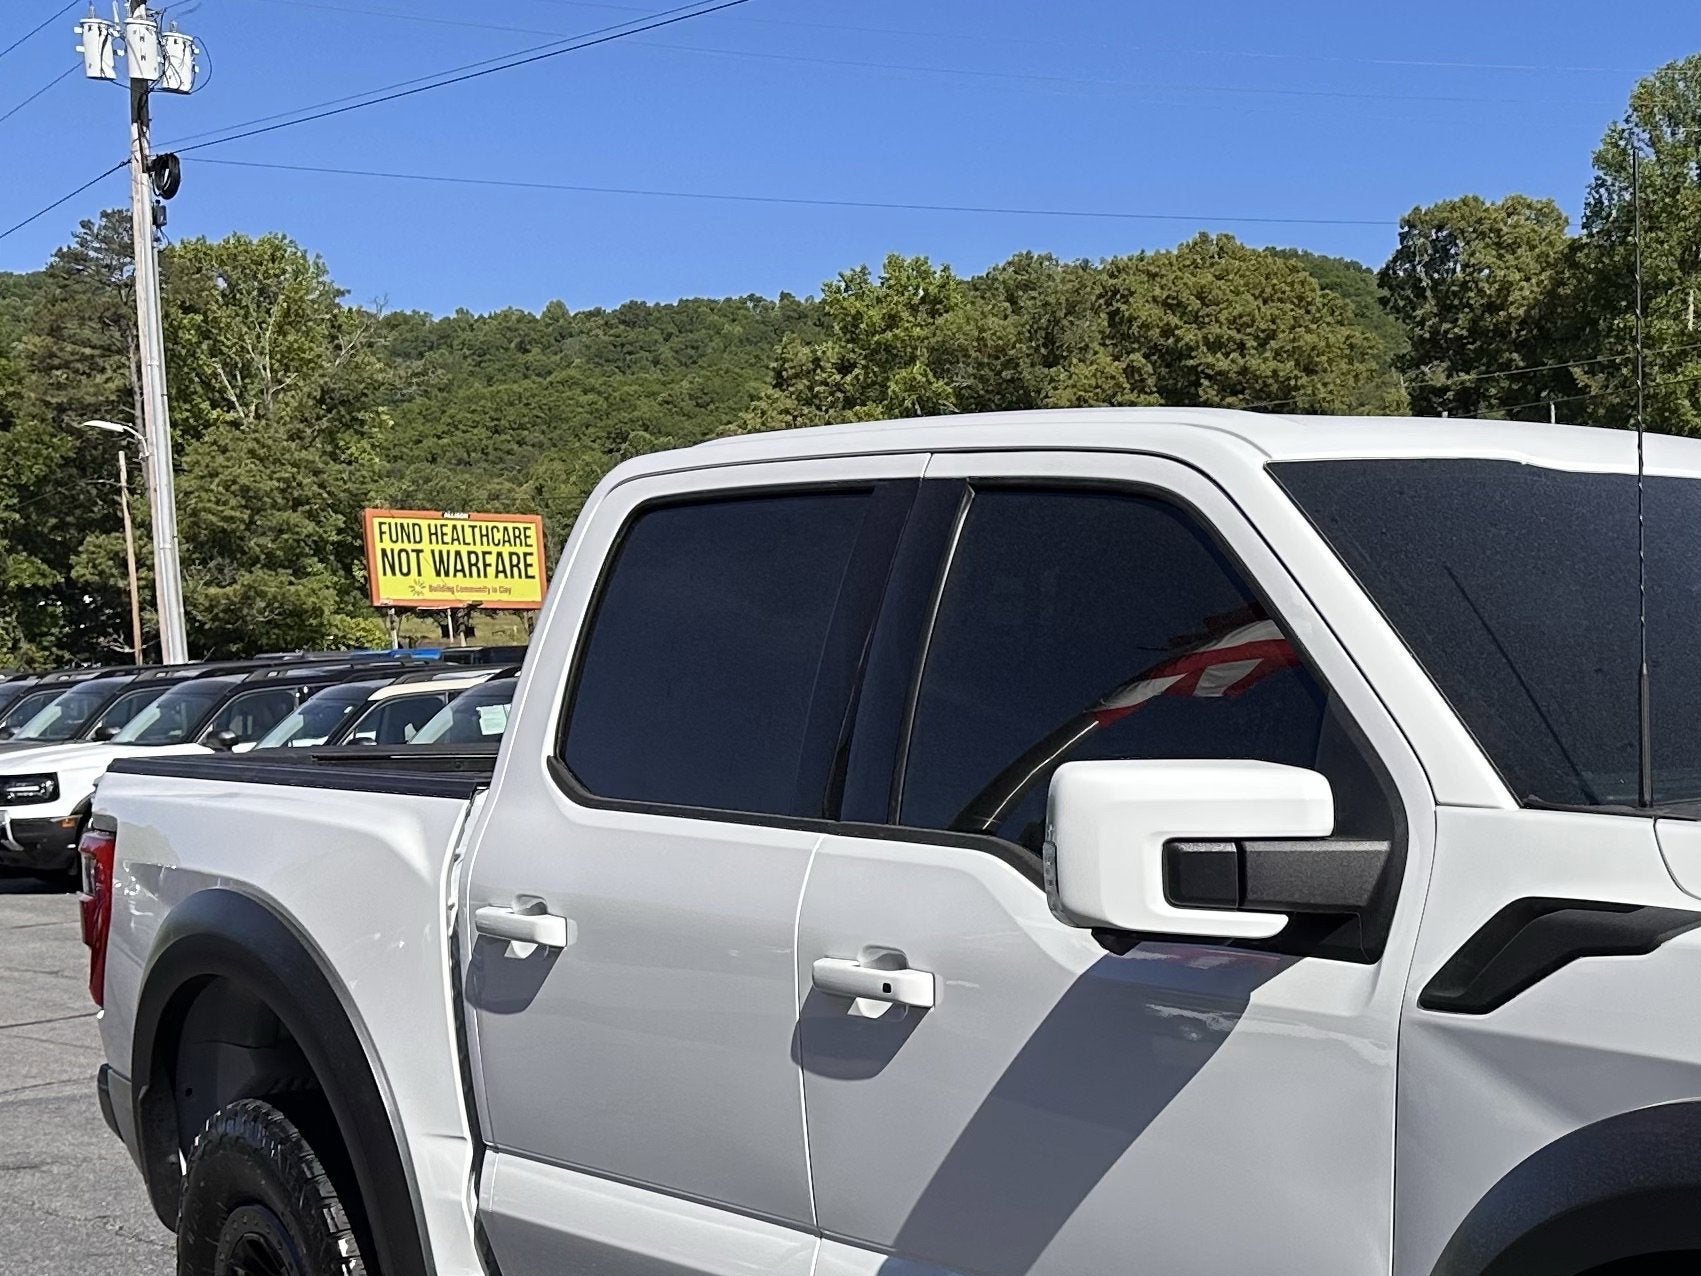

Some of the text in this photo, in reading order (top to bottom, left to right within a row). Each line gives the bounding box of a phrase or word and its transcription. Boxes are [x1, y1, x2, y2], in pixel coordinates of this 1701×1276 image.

[378, 521, 534, 548] FUND HEALTHCARE
[381, 548, 537, 580] NOT WARFARE
